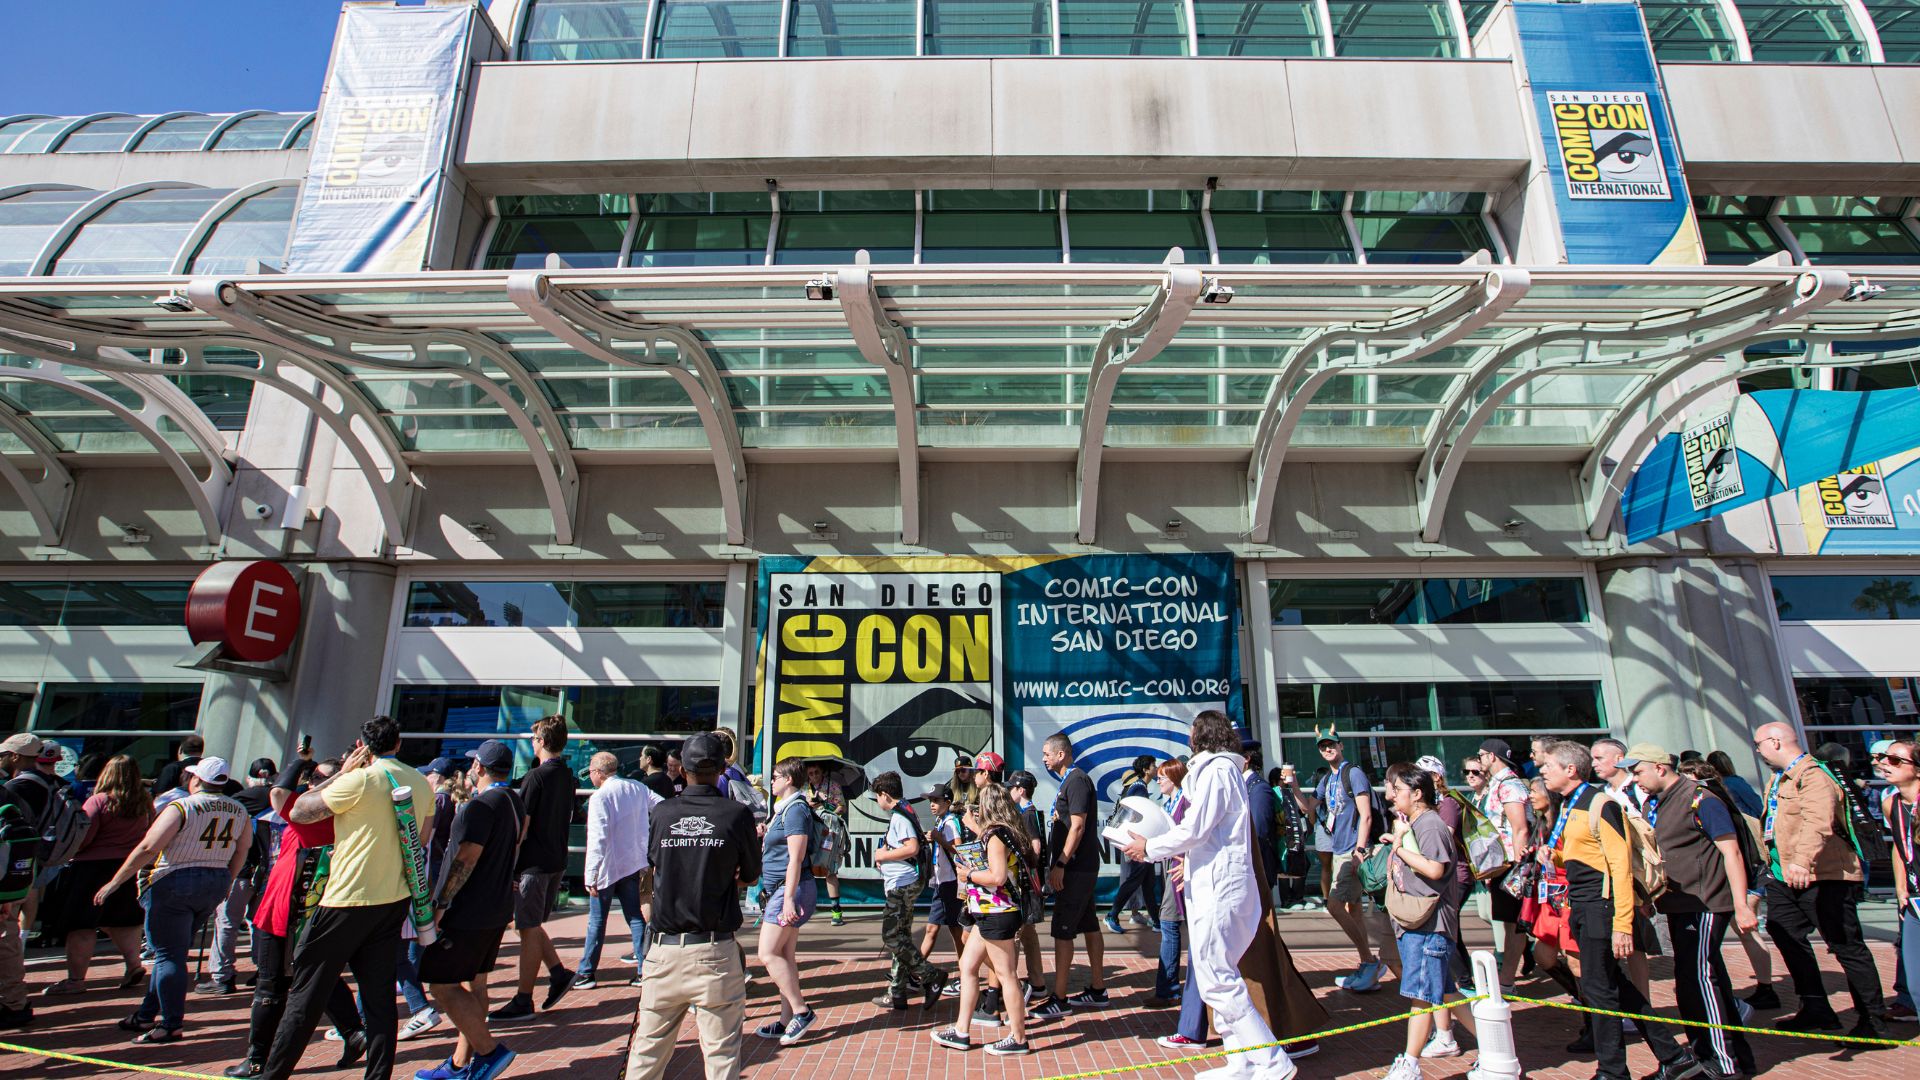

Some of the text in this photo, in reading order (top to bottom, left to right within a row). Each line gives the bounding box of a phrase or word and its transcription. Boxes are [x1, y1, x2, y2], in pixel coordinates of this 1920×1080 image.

[1550, 94, 1642, 103] SAN DIEGO
[371, 107, 429, 133] CON
[1587, 104, 1648, 129] CON
[327, 108, 370, 186] COMIC
[1555, 104, 1599, 182] COMIC
[322, 186, 410, 201] INTERNATIONA
[1570, 183, 1666, 196] INTERNATIONAL
[1682, 415, 1728, 441] SAN DIEGO
[1700, 424, 1731, 455] CON
[1685, 439, 1708, 498] COMIC
[1694, 483, 1742, 508] INTERNATIONAL
[1818, 474, 1847, 515] COM
[1826, 516, 1893, 526] INTERNATIONAL
[778, 582, 993, 607] SAN DIEGO
[1044, 575, 1198, 599] COMIC-CON
[244, 580, 284, 642] E
[1017, 601, 1229, 626] INTERNATIONAL
[855, 614, 990, 683] CON
[1051, 628, 1198, 652] SAN DIEGO
[1013, 678, 1230, 699] WWW.COMIC-CON.ORG
[195, 800, 242, 818] MUSGROVE
[199, 816, 234, 850] 44
[660, 837, 725, 848] SECURITY STAFF
